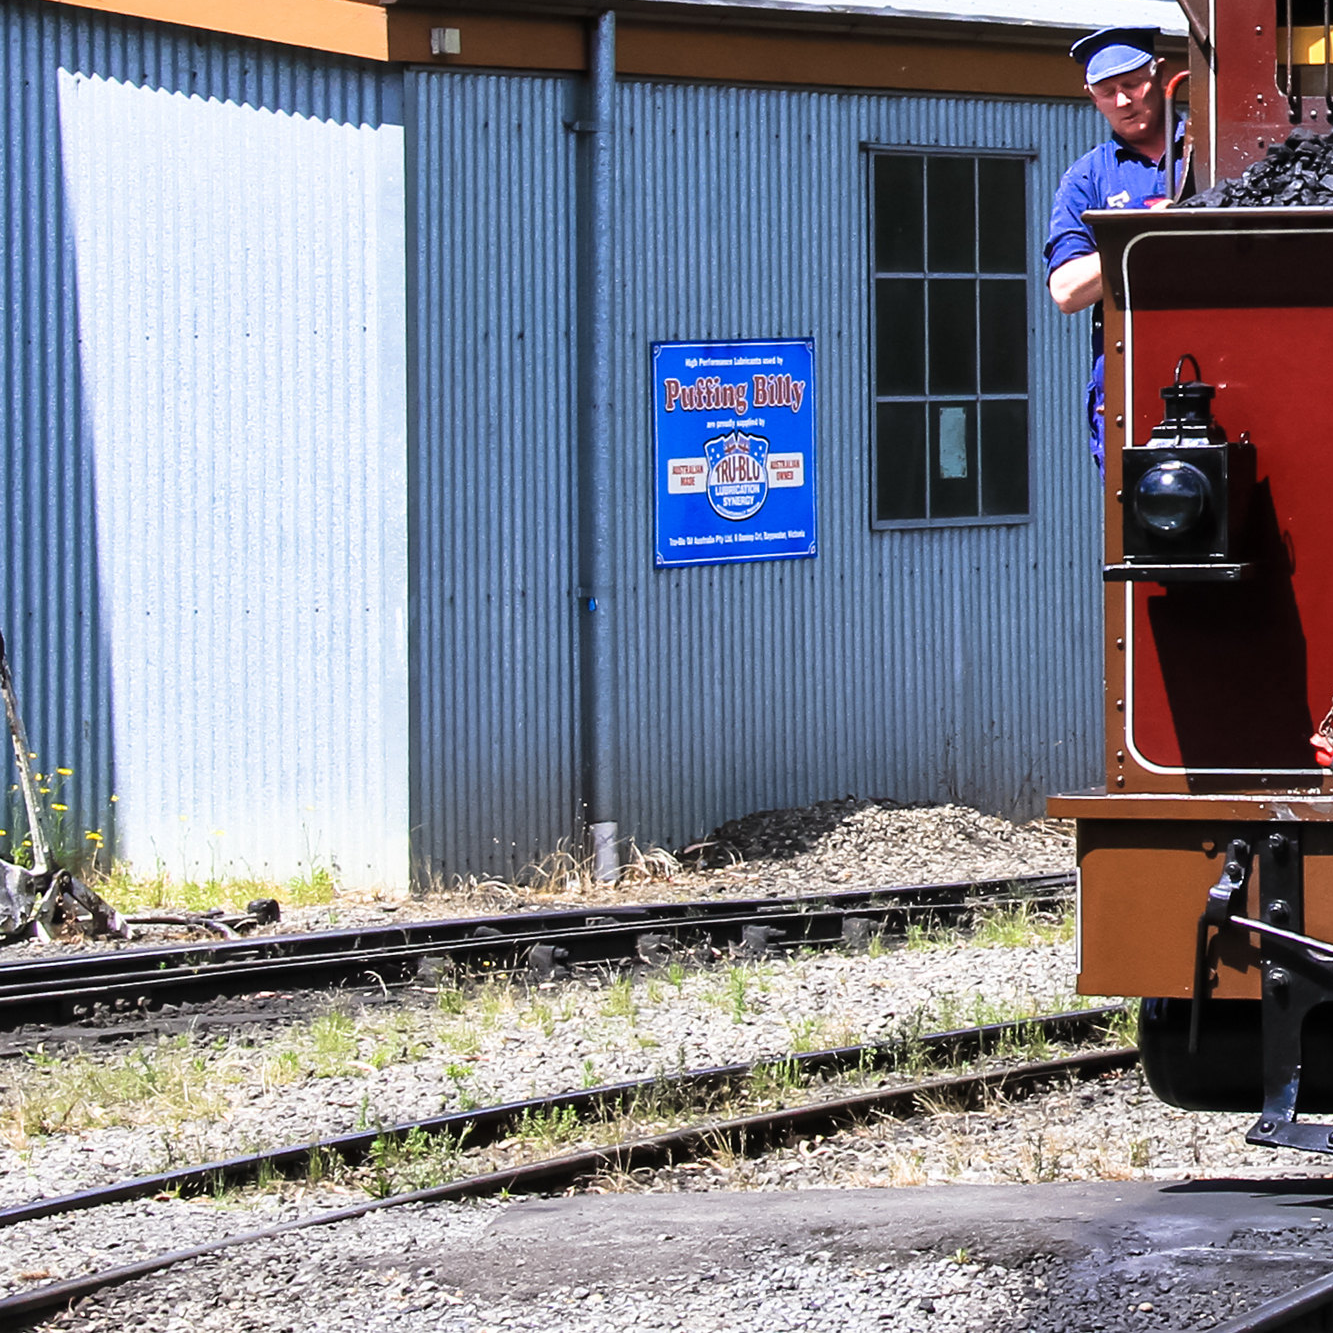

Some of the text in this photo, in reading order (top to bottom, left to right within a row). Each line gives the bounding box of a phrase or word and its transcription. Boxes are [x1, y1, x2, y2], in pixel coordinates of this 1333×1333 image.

[664, 373, 805, 415] Puffing Billy
[715, 484, 760, 496] LUBRICATION
[723, 496, 755, 506] SYNERGY
